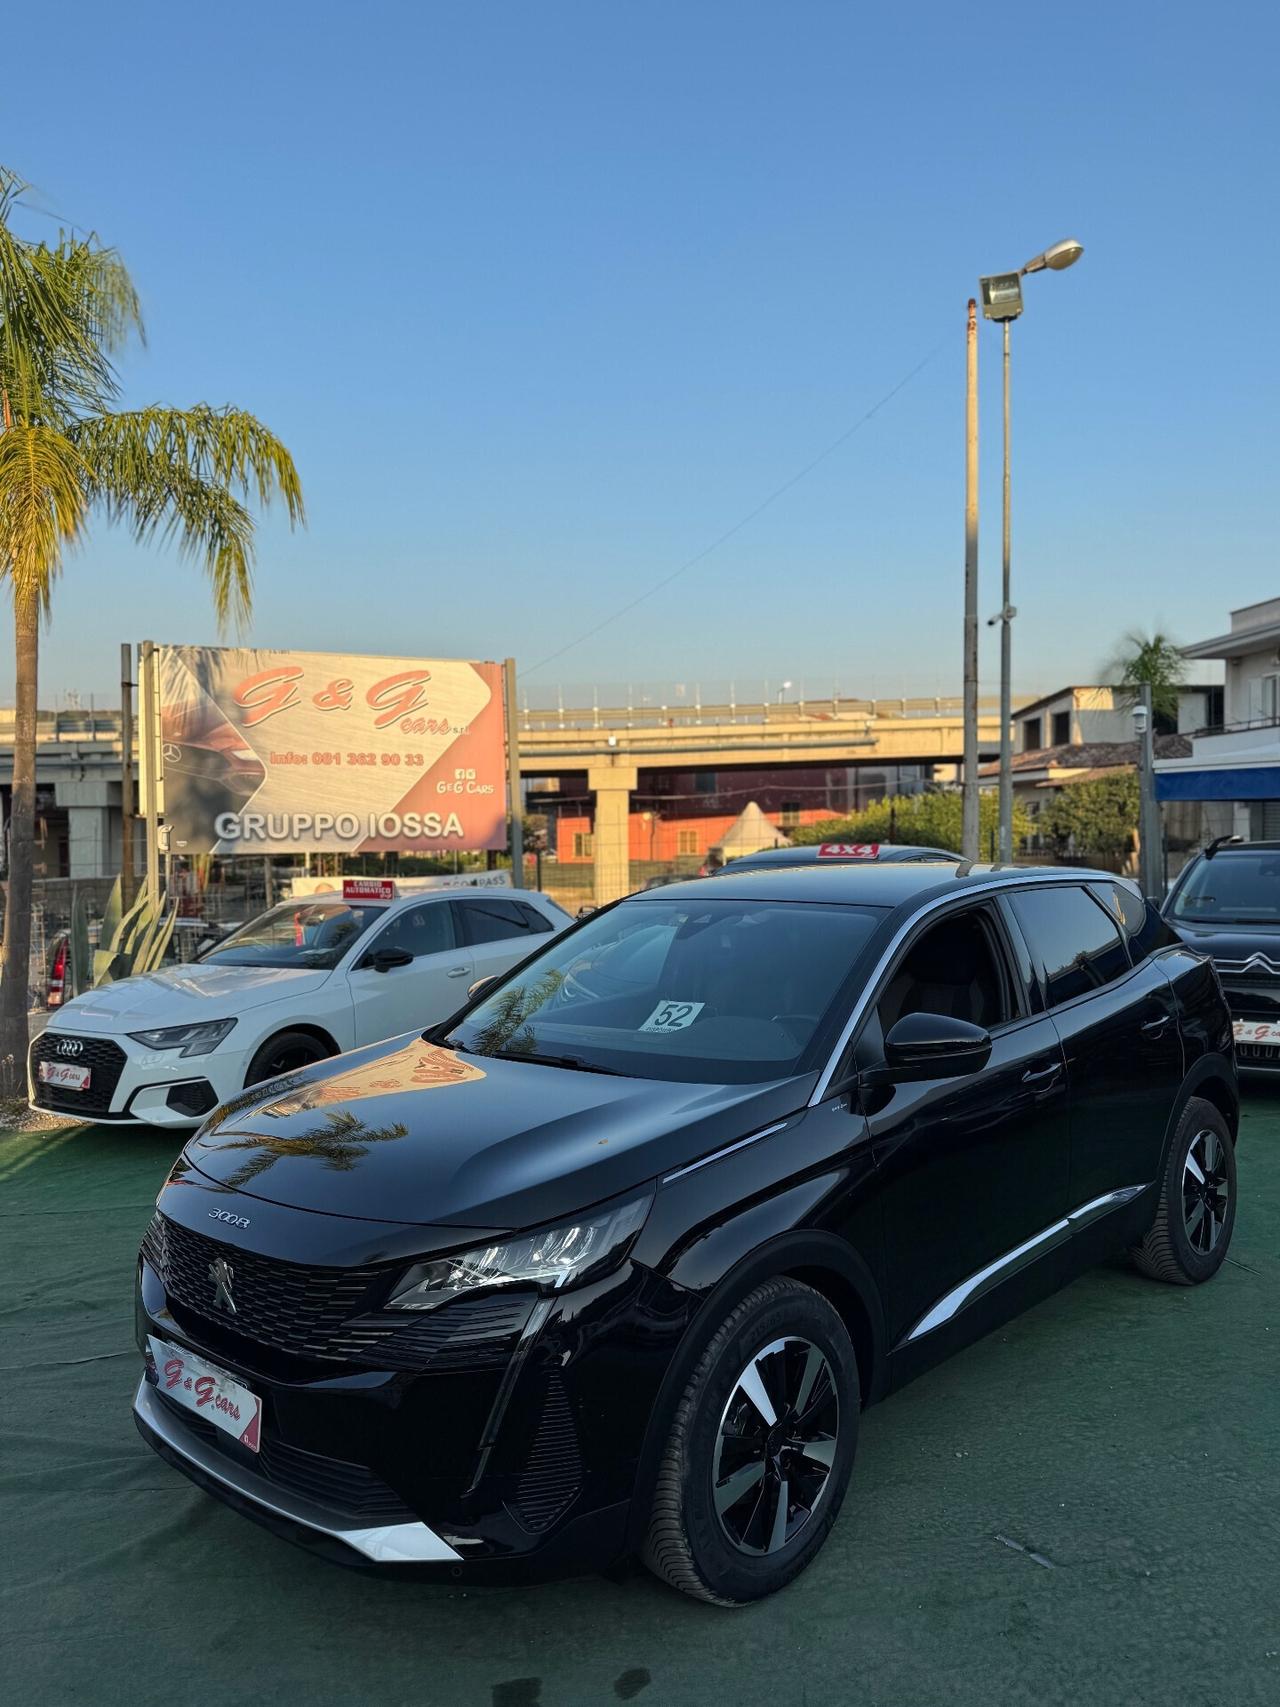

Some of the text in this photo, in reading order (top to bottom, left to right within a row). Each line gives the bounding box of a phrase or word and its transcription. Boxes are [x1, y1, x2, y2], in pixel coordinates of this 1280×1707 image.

[234, 666, 431, 729] G & G
[400, 717, 451, 736] cars
[270, 751, 424, 767] Info: 081 362 90 33
[214, 812, 464, 840] GRUPPO IOSSA
[654, 1004, 693, 1027] 52
[208, 1207, 251, 1229] 3008
[164, 1360, 241, 1421] G & G cars
